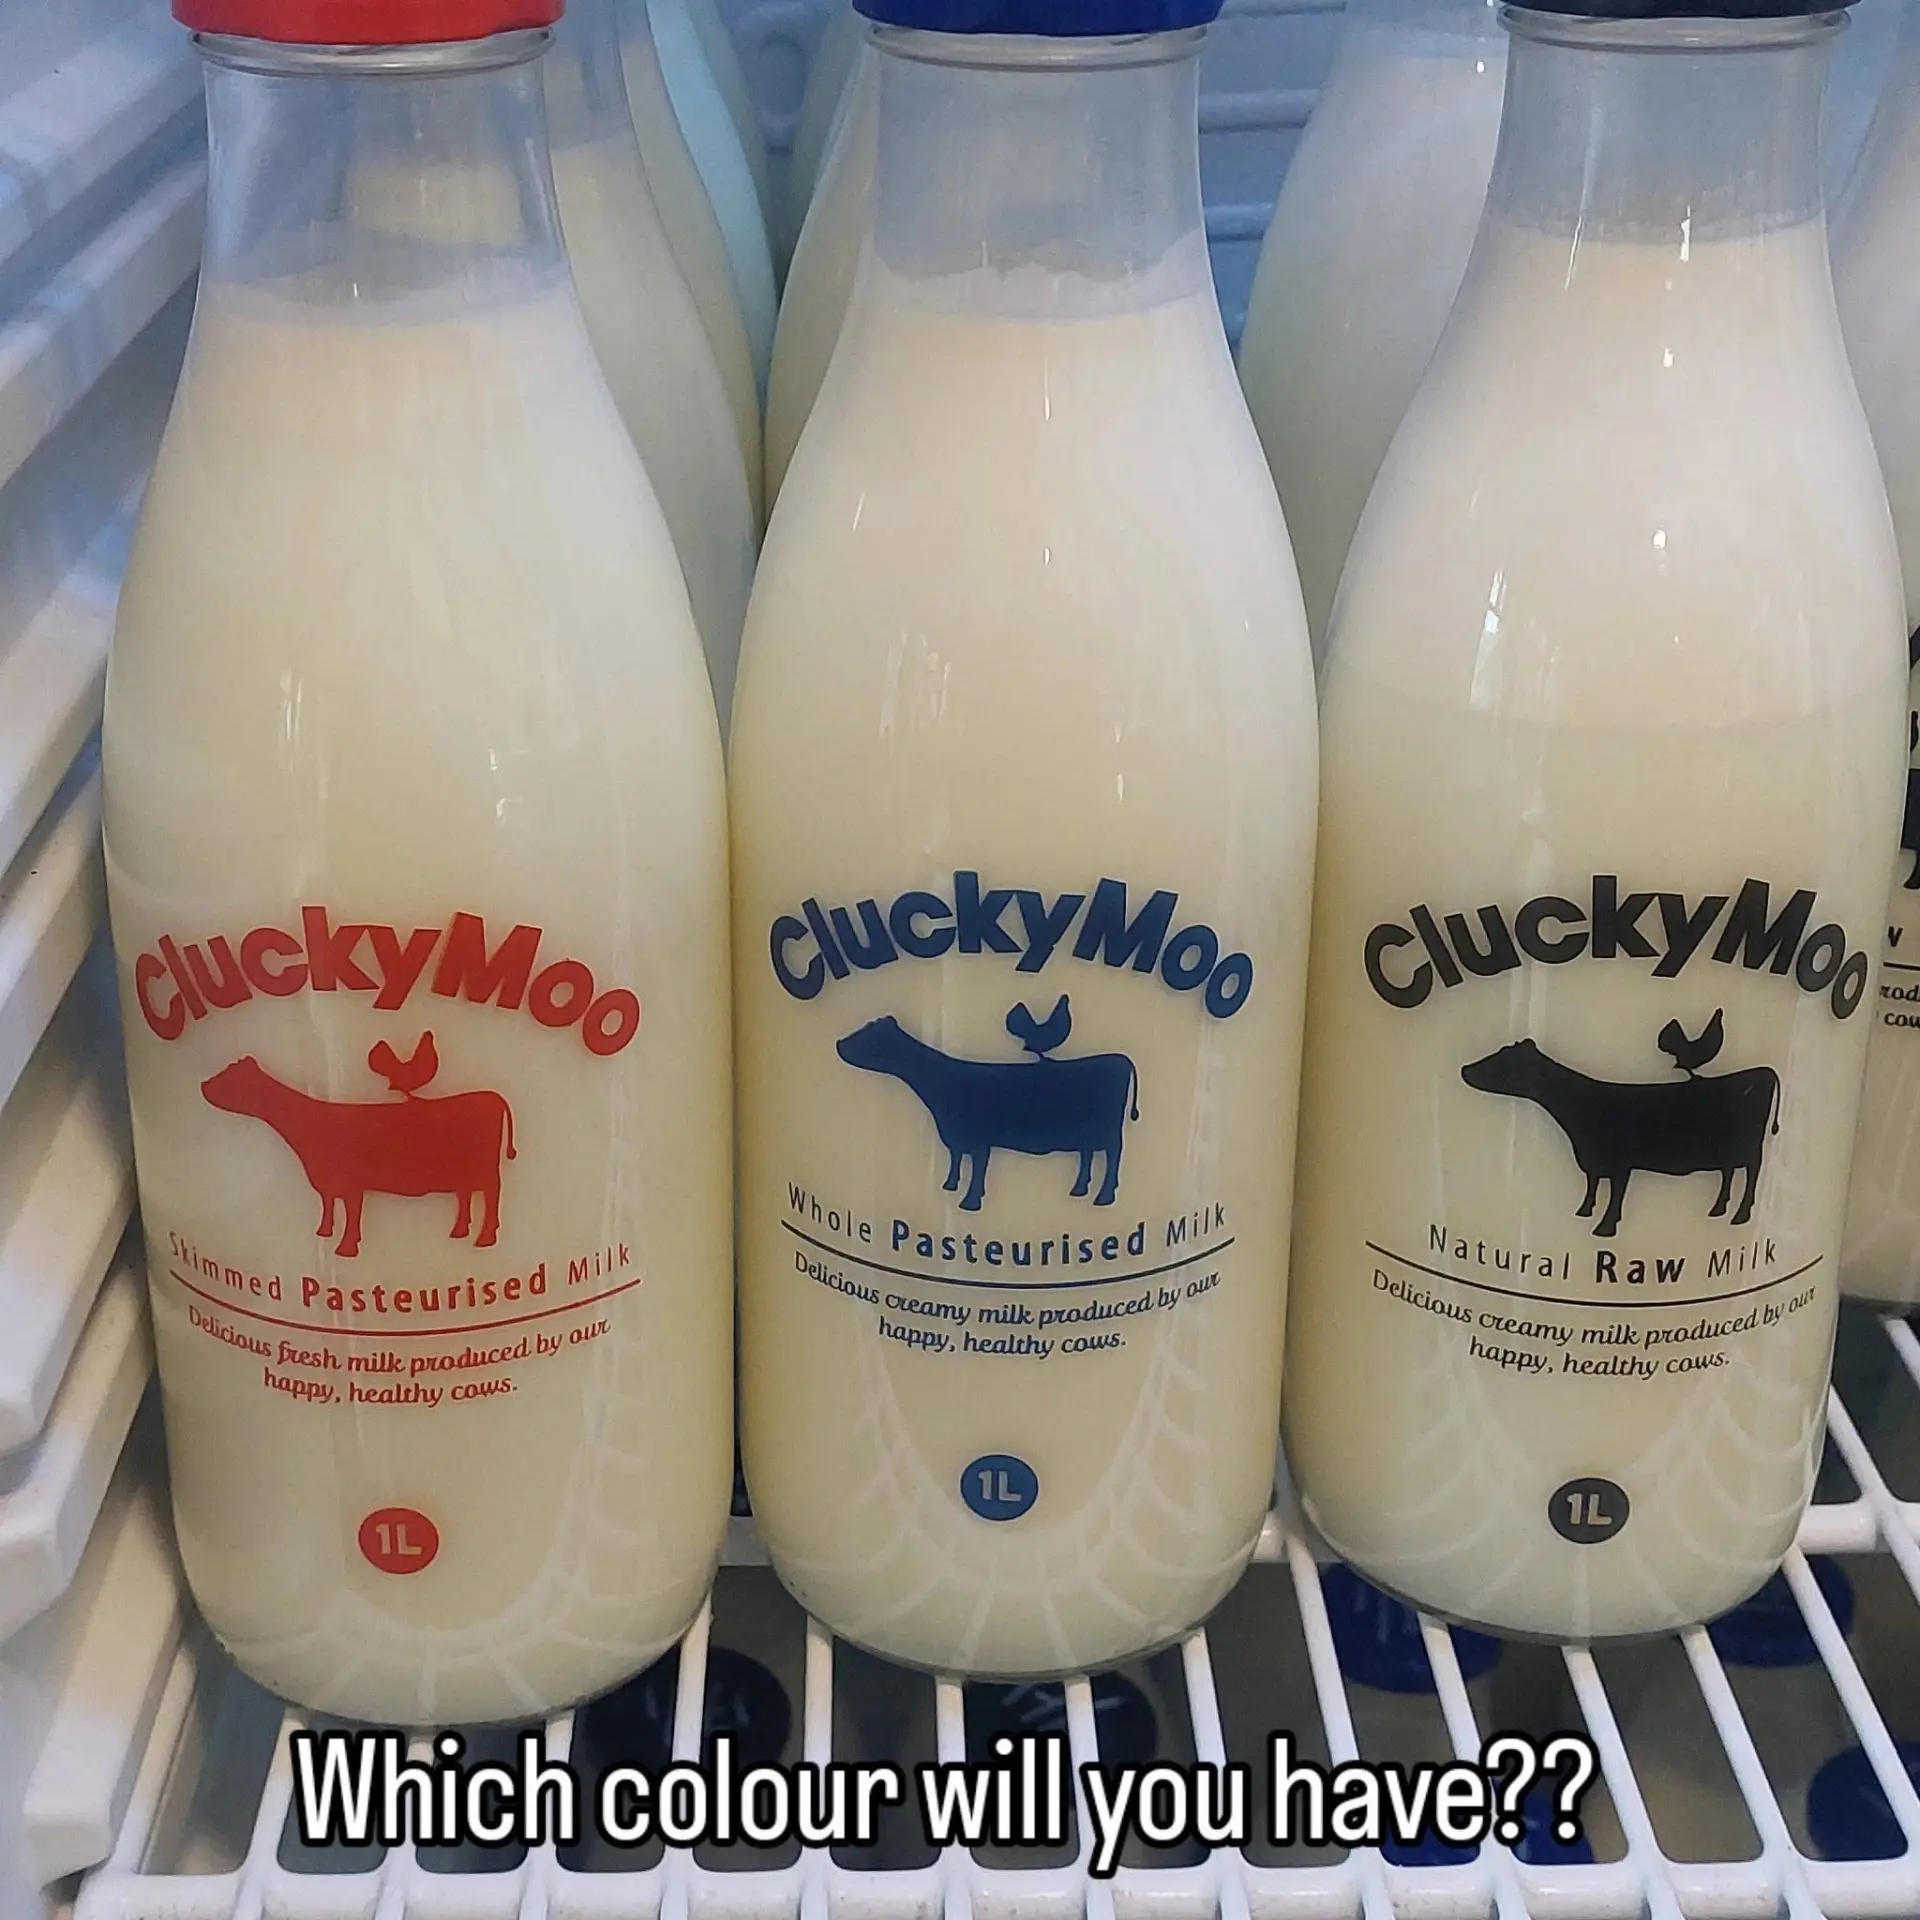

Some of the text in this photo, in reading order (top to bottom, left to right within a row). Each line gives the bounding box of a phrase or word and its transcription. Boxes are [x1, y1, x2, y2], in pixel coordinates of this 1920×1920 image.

[135, 906, 640, 1056] CluckyMoo
[770, 871, 1253, 1018] CluckyMoo
[1364, 875, 1868, 1019] CluckyMoo
[788, 1181, 1225, 1266] Whole Pasteurised Milk
[1429, 1224, 1776, 1284] Natural Raw Milk
[169, 1231, 630, 1313] Skimmed Pasteurised Milk
[795, 1250, 1220, 1330] Delicious creamy milk produced by our
[1372, 1268, 1816, 1350] Delicious creamy milk produced by our
[189, 1304, 611, 1378] Delicious fresh milk produced by our
[879, 1315, 1127, 1360] happy, healthy cows.
[1468, 1335, 1731, 1381] happy, healthy cows.
[264, 1366, 518, 1408] happy, healthy cows.
[978, 1470, 1022, 1502] 1L
[1567, 1493, 1612, 1525] 1L
[375, 1523, 422, 1555] 1L
